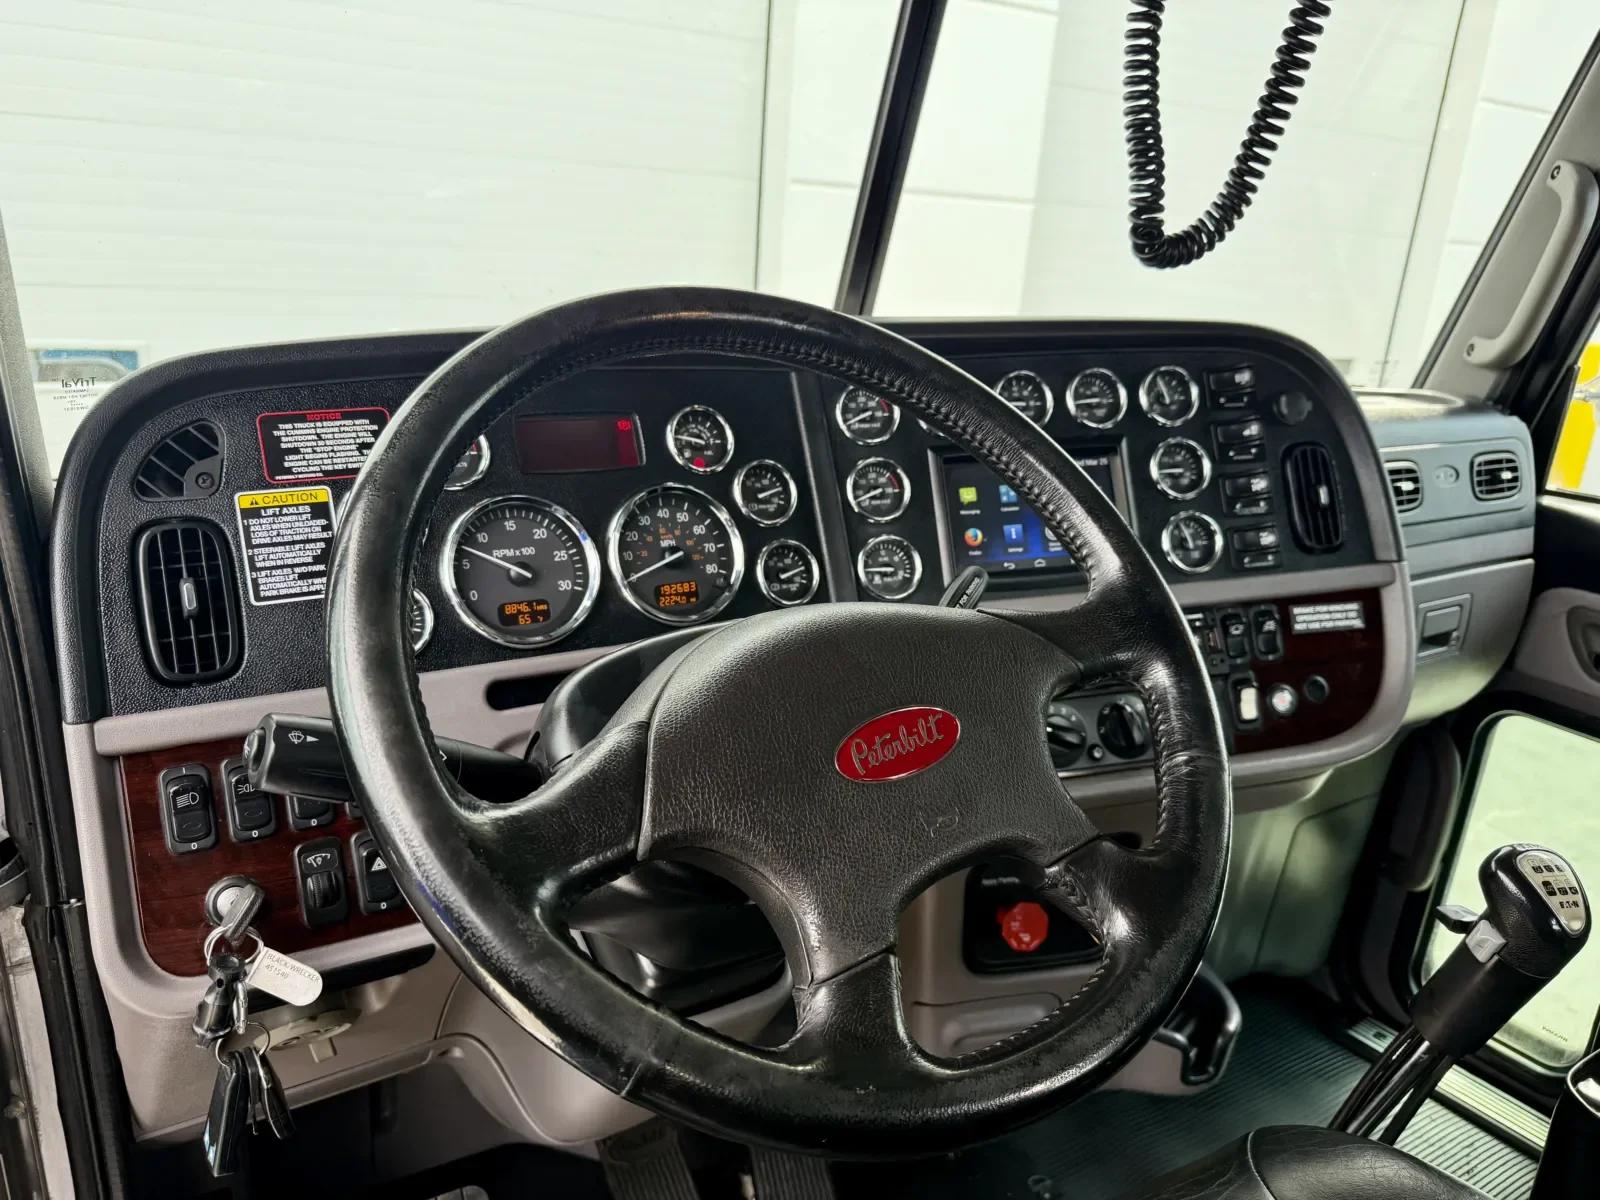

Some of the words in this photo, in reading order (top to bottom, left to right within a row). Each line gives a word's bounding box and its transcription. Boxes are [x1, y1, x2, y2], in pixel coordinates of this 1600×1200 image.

[322, 420, 354, 428] EQUIPPED
[262, 492, 318, 504] CAUTION
[261, 508, 280, 516] LIFT
[282, 505, 311, 514] AXLES
[657, 508, 669, 518] 40
[638, 516, 650, 526] 30
[676, 512, 688, 522] 50
[504, 520, 516, 531] 15
[693, 525, 705, 535] 60
[477, 532, 488, 543] 10
[533, 528, 547, 539] 20
[626, 531, 638, 541] 20
[254, 546, 291, 554] STEERABLE
[493, 549, 515, 558] RPM
[521, 547, 535, 556] 100
[704, 543, 716, 552] 70
[269, 549, 322, 560] AUTOMATICALLY
[553, 550, 568, 561] 25
[623, 551, 632, 561] 10
[284, 556, 313, 565] REVERSE
[462, 560, 470, 569] 5
[706, 564, 718, 574] 80
[260, 579, 312, 590] AUTOMATICALLY
[558, 580, 572, 591] 30
[470, 590, 478, 600] 0
[519, 614, 531, 624] 65
[851, 712, 944, 775] Peterbilt
